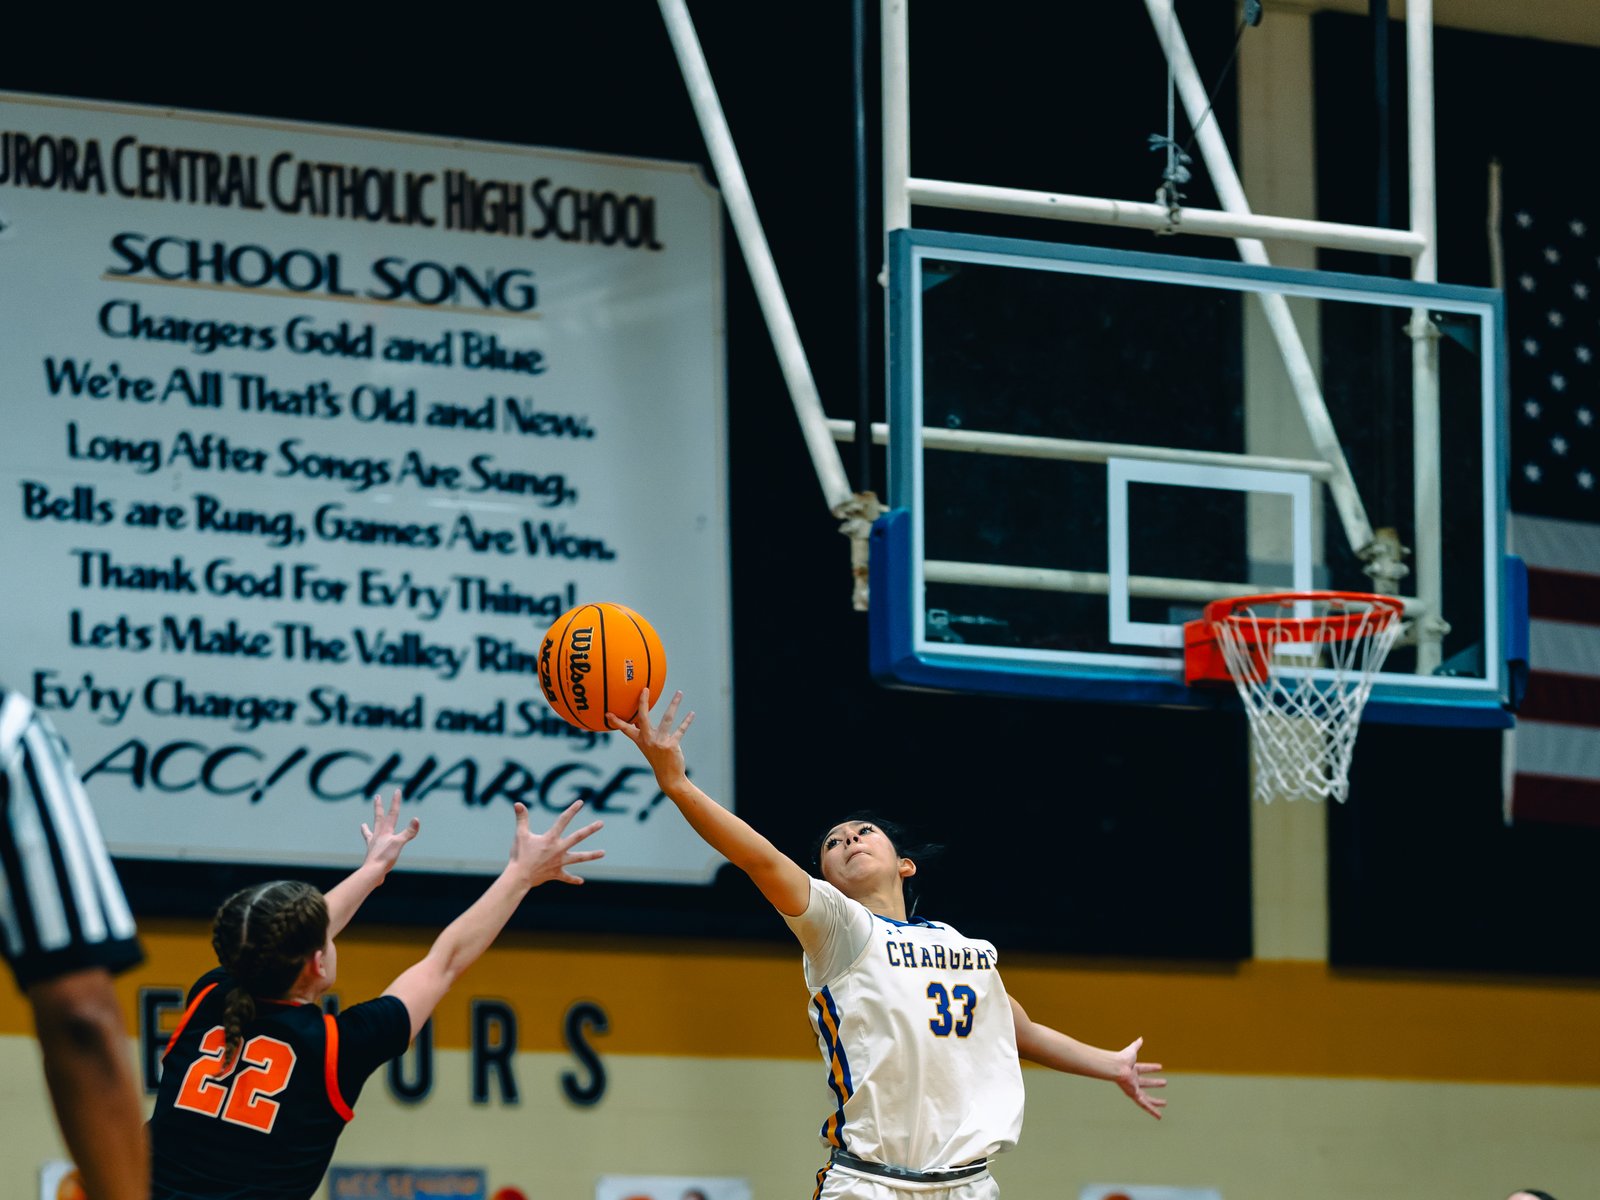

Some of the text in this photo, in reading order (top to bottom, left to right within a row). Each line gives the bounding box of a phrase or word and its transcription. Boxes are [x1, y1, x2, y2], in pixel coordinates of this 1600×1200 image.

[112, 136, 264, 211] CENTRAL
[269, 152, 437, 227] CATHOLIC
[443, 168, 524, 237] HIGH
[530, 178, 665, 251] SCHOOL
[105, 232, 537, 313] SCHOOL SONG
[98, 299, 546, 375] Chargers Gold and Blue
[44, 356, 156, 402] We're
[161, 368, 223, 408] All
[230, 373, 342, 418] That's
[351, 384, 416, 424] Old
[426, 396, 496, 432] and
[67, 421, 162, 474] Long
[168, 431, 269, 473] After
[274, 439, 392, 492] Songs
[400, 450, 462, 490] Are
[19, 480, 114, 525] Bells
[125, 503, 189, 530] are
[192, 495, 306, 547] Rung,
[314, 503, 441, 549] Games
[448, 514, 516, 554] Are
[69, 549, 198, 594] Thank
[204, 558, 284, 599] God
[292, 564, 349, 603] For
[358, 568, 449, 621] Ev'ry
[69, 608, 153, 649] Lets
[161, 615, 271, 659] Make
[274, 621, 349, 663] The
[353, 627, 470, 681] Valley
[570, 627, 594, 711] Wilson
[33, 669, 134, 726] Ev'ry
[144, 675, 298, 732] Charger
[305, 686, 423, 730] Stand
[434, 699, 505, 735] and
[926, 981, 978, 1038] 33
[174, 1025, 298, 1132] 22
